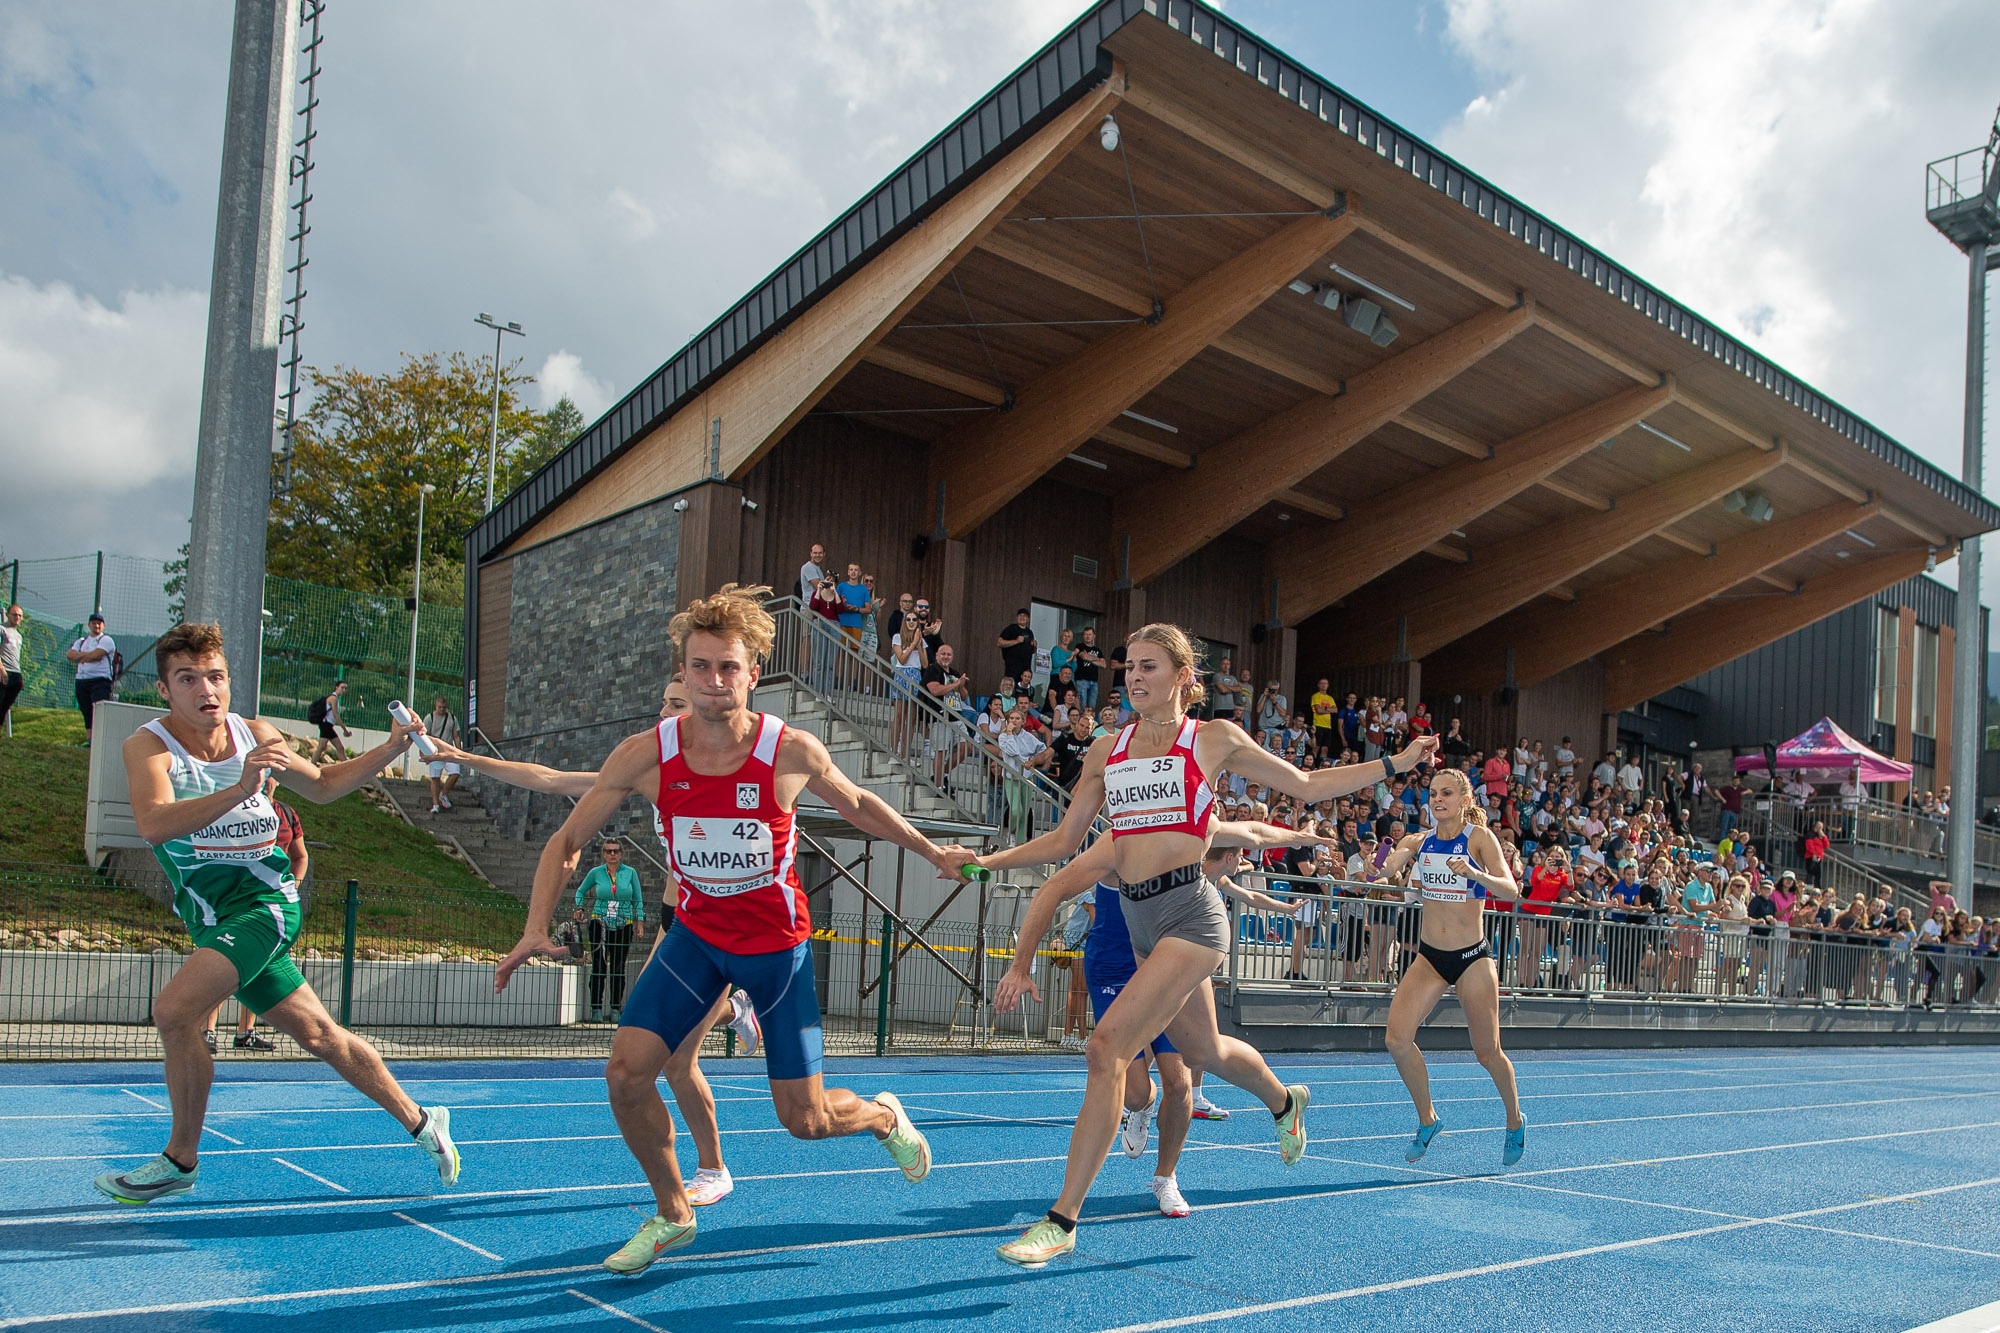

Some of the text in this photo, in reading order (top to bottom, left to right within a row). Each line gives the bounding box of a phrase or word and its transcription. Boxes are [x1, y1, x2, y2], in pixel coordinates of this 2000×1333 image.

[1117, 766, 1138, 775] SPORT
[1151, 758, 1174, 774] 35
[1107, 781, 1182, 807] GAJEWSKA
[241, 796, 260, 810] 18
[193, 816, 277, 839] ADAMCZEWSKI
[1115, 814, 1174, 829] KARPACZ 2022
[732, 822, 759, 840] 42
[198, 851, 247, 860] KARPACZ
[249, 847, 272, 859] 2022
[676, 850, 770, 869] LAMPART
[735, 879, 761, 892] 2022
[1423, 872, 1458, 885] BEKUS
[1128, 876, 1162, 899] PRO
[1462, 947, 1479, 960] NIKE
